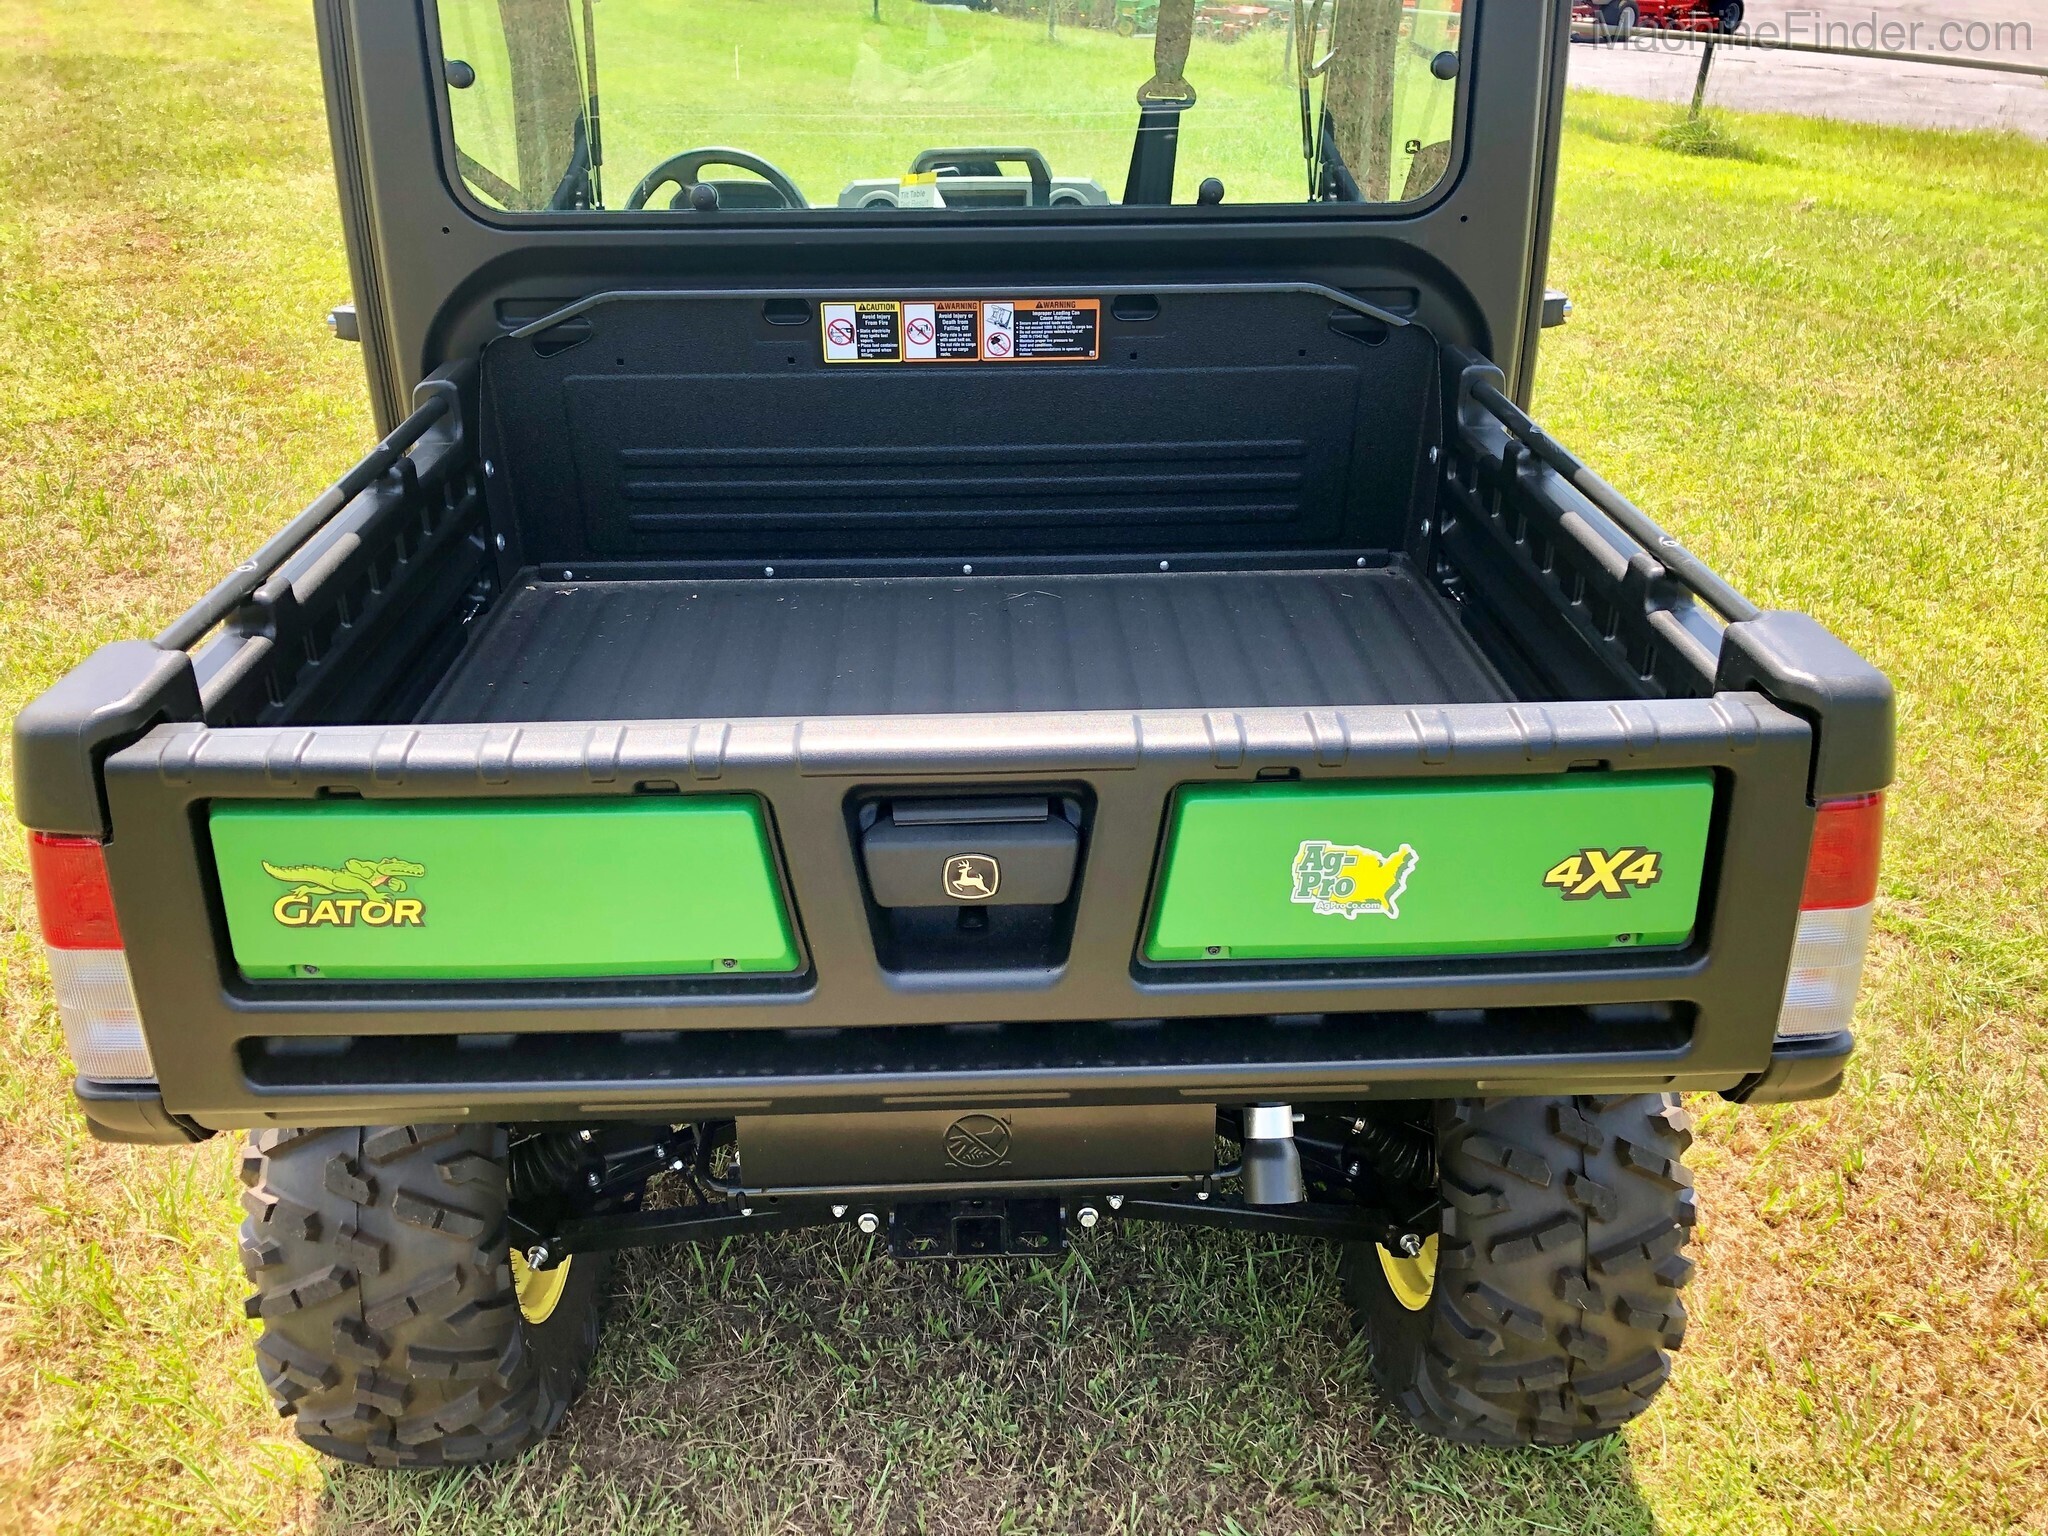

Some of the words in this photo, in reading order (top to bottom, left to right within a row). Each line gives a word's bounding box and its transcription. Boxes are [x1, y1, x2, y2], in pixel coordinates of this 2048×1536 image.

[910, 190, 926, 198] Table
[1297, 844, 1357, 877] Ag-
[1543, 848, 1660, 897] 4X4
[1296, 871, 1355, 898] Pro
[273, 894, 425, 926] GATOR
[1315, 900, 1382, 911] AgProCo.com
